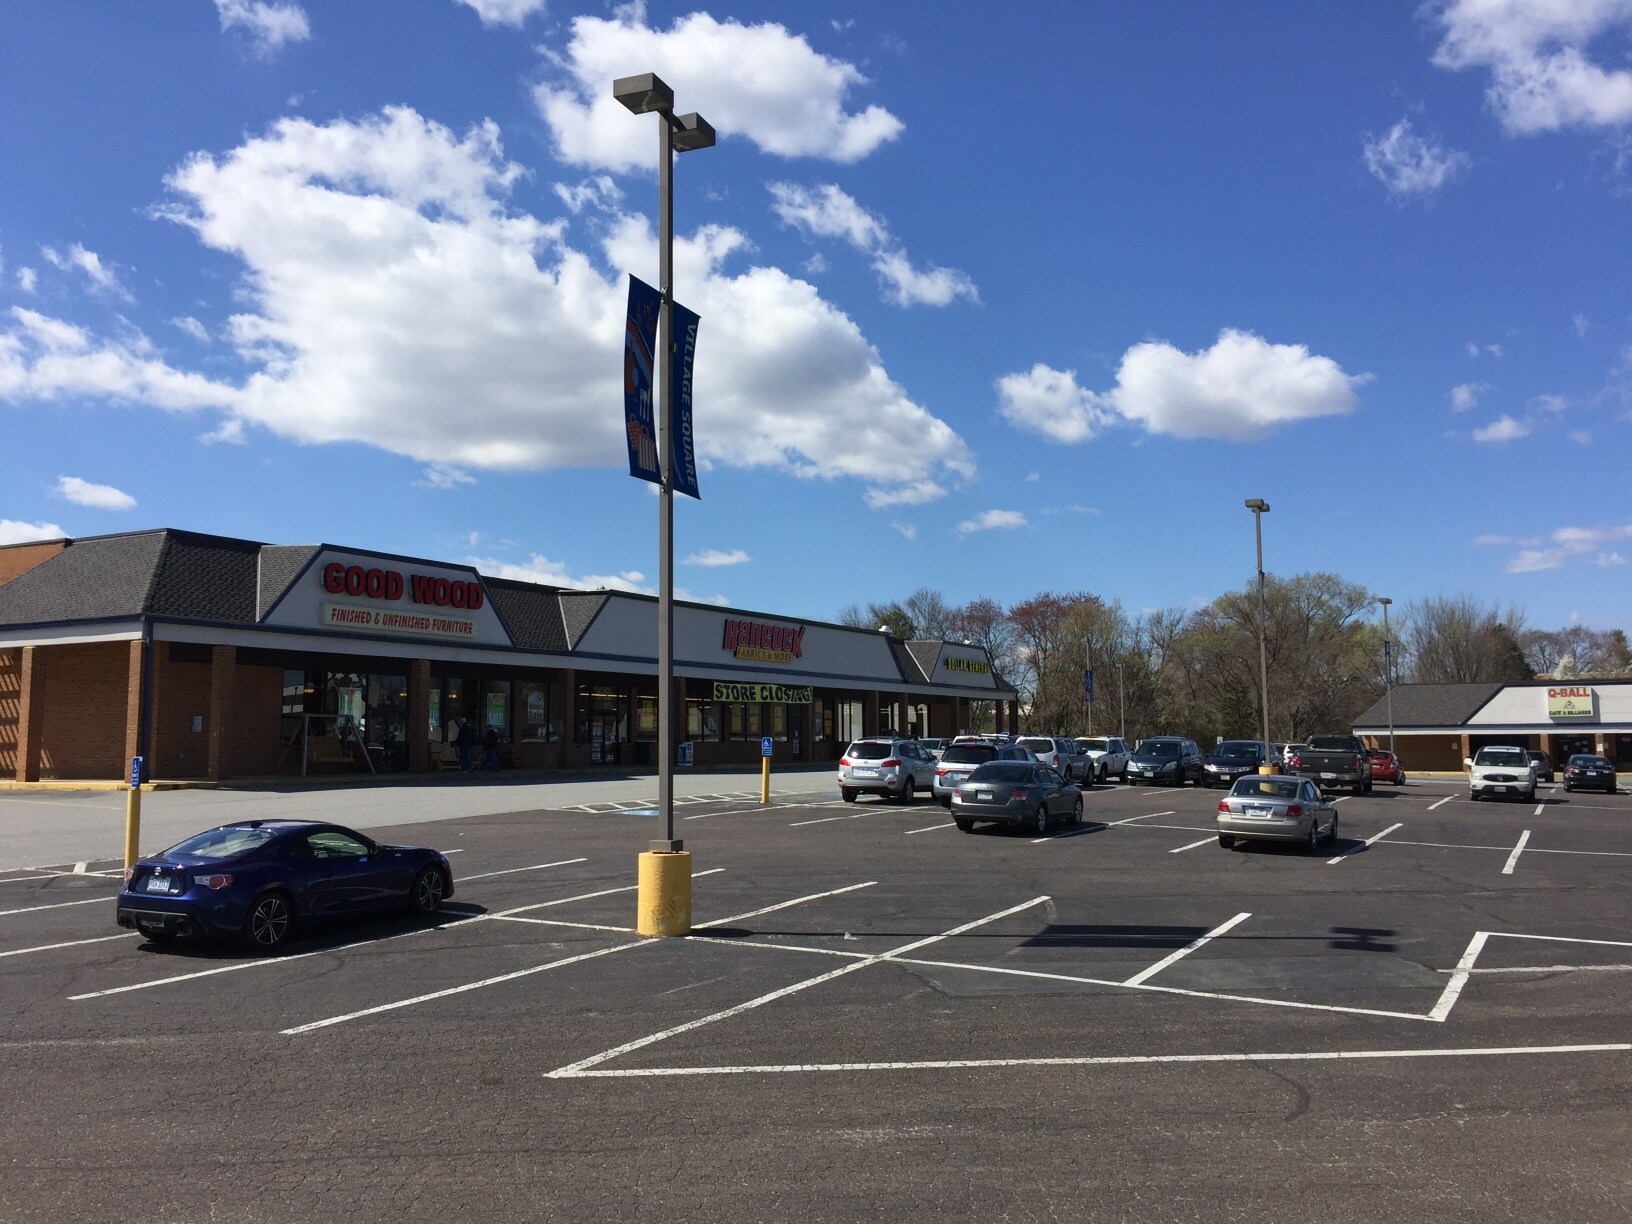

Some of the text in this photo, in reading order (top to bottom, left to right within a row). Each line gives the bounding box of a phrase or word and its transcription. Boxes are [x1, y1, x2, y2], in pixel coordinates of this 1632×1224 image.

[681, 324, 697, 488] VILLAGE SQUARE
[323, 562, 484, 610] GOOD WOOD
[331, 607, 473, 635] FINISHED & UNFINISHED FURNITURE
[737, 647, 766, 660] FABRICS
[774, 652, 792, 662] MORE
[714, 683, 813, 703] STORE CLOSING!
[1548, 688, 1590, 698] Q-BALL
